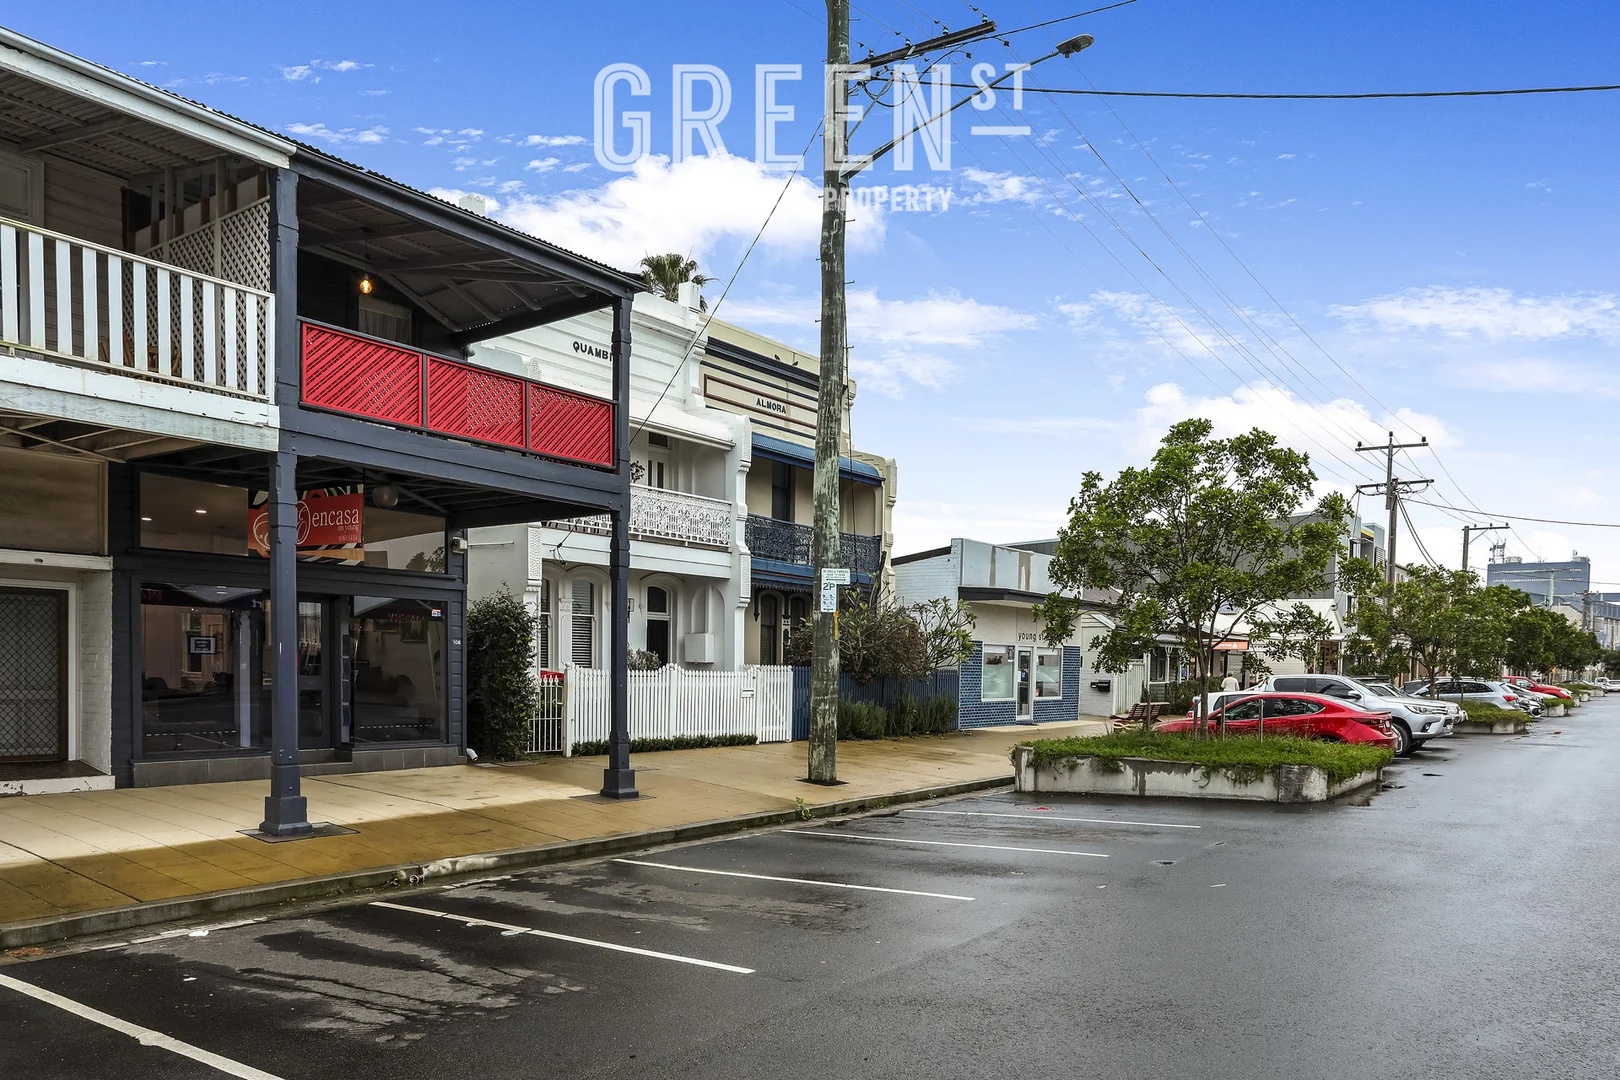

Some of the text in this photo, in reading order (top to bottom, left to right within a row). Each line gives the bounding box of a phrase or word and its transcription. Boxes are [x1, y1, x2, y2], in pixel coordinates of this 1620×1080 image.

[756, 398, 786, 414] ALMORA
[312, 508, 359, 527] encasa
[823, 582, 835, 590] 2P
[1018, 632, 1036, 642] young
